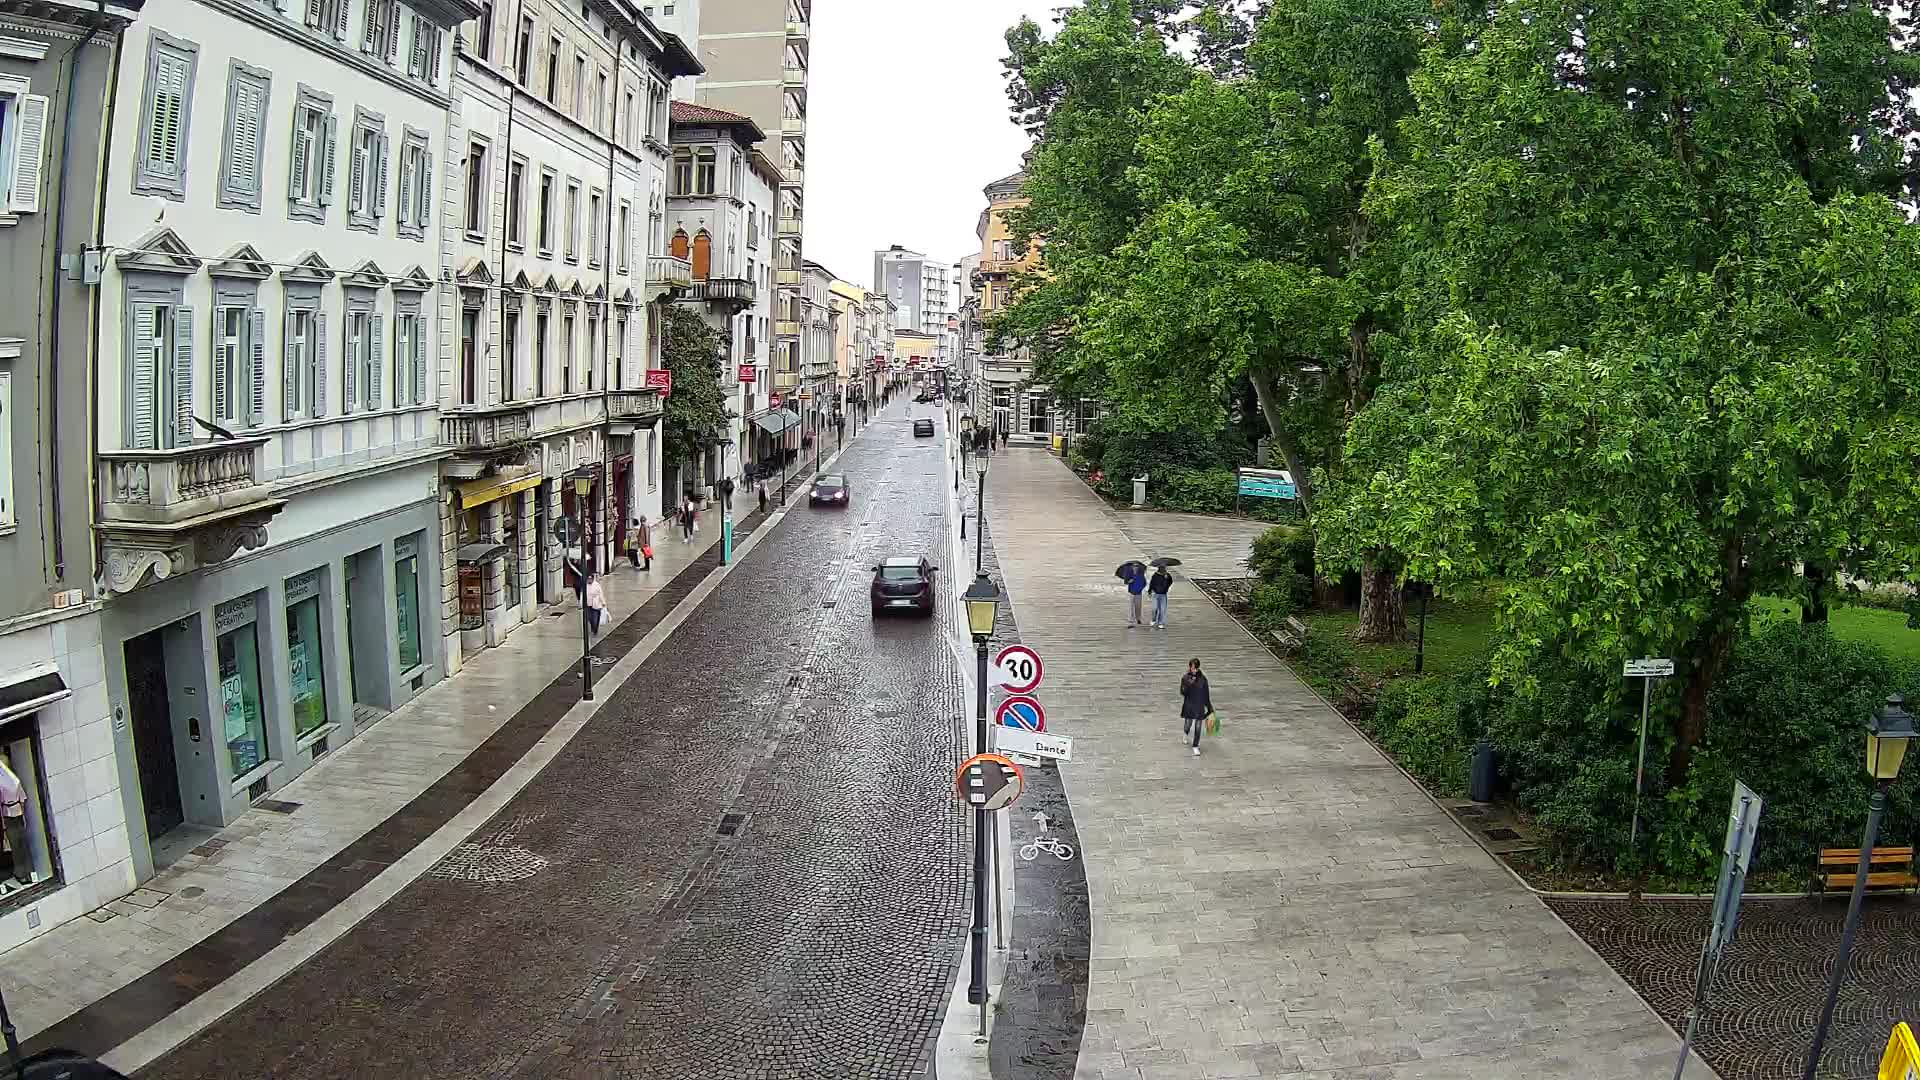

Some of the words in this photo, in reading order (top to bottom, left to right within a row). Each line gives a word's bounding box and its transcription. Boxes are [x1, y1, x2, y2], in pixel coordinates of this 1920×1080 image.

[1006, 659, 1032, 681] 30
[224, 679, 241, 702] 130
[1036, 742, 1066, 755] Dante
